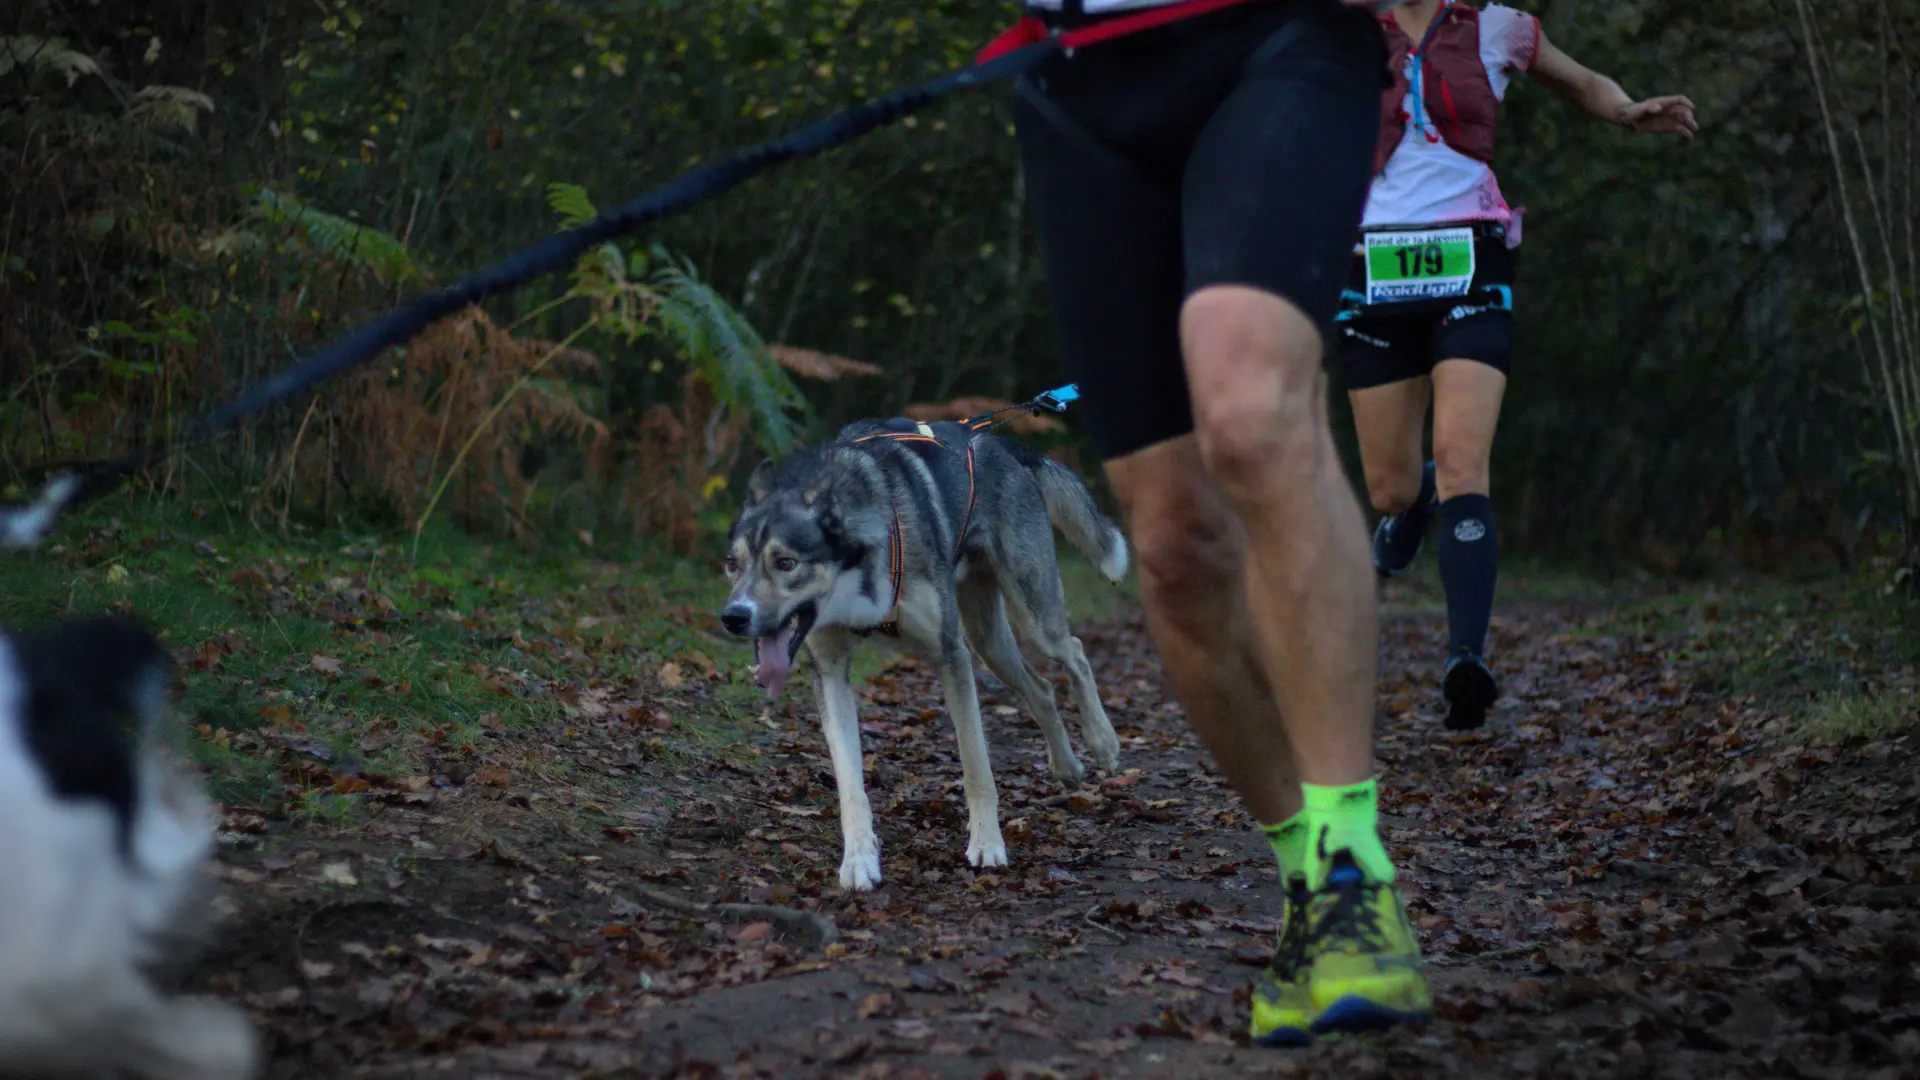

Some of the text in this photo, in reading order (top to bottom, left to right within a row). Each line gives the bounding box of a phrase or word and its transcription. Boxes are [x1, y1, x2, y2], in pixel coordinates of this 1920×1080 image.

[1368, 237, 1393, 246] Raid
[1396, 236, 1410, 245] de
[1413, 235, 1424, 244] la
[1394, 246, 1444, 277] 179
